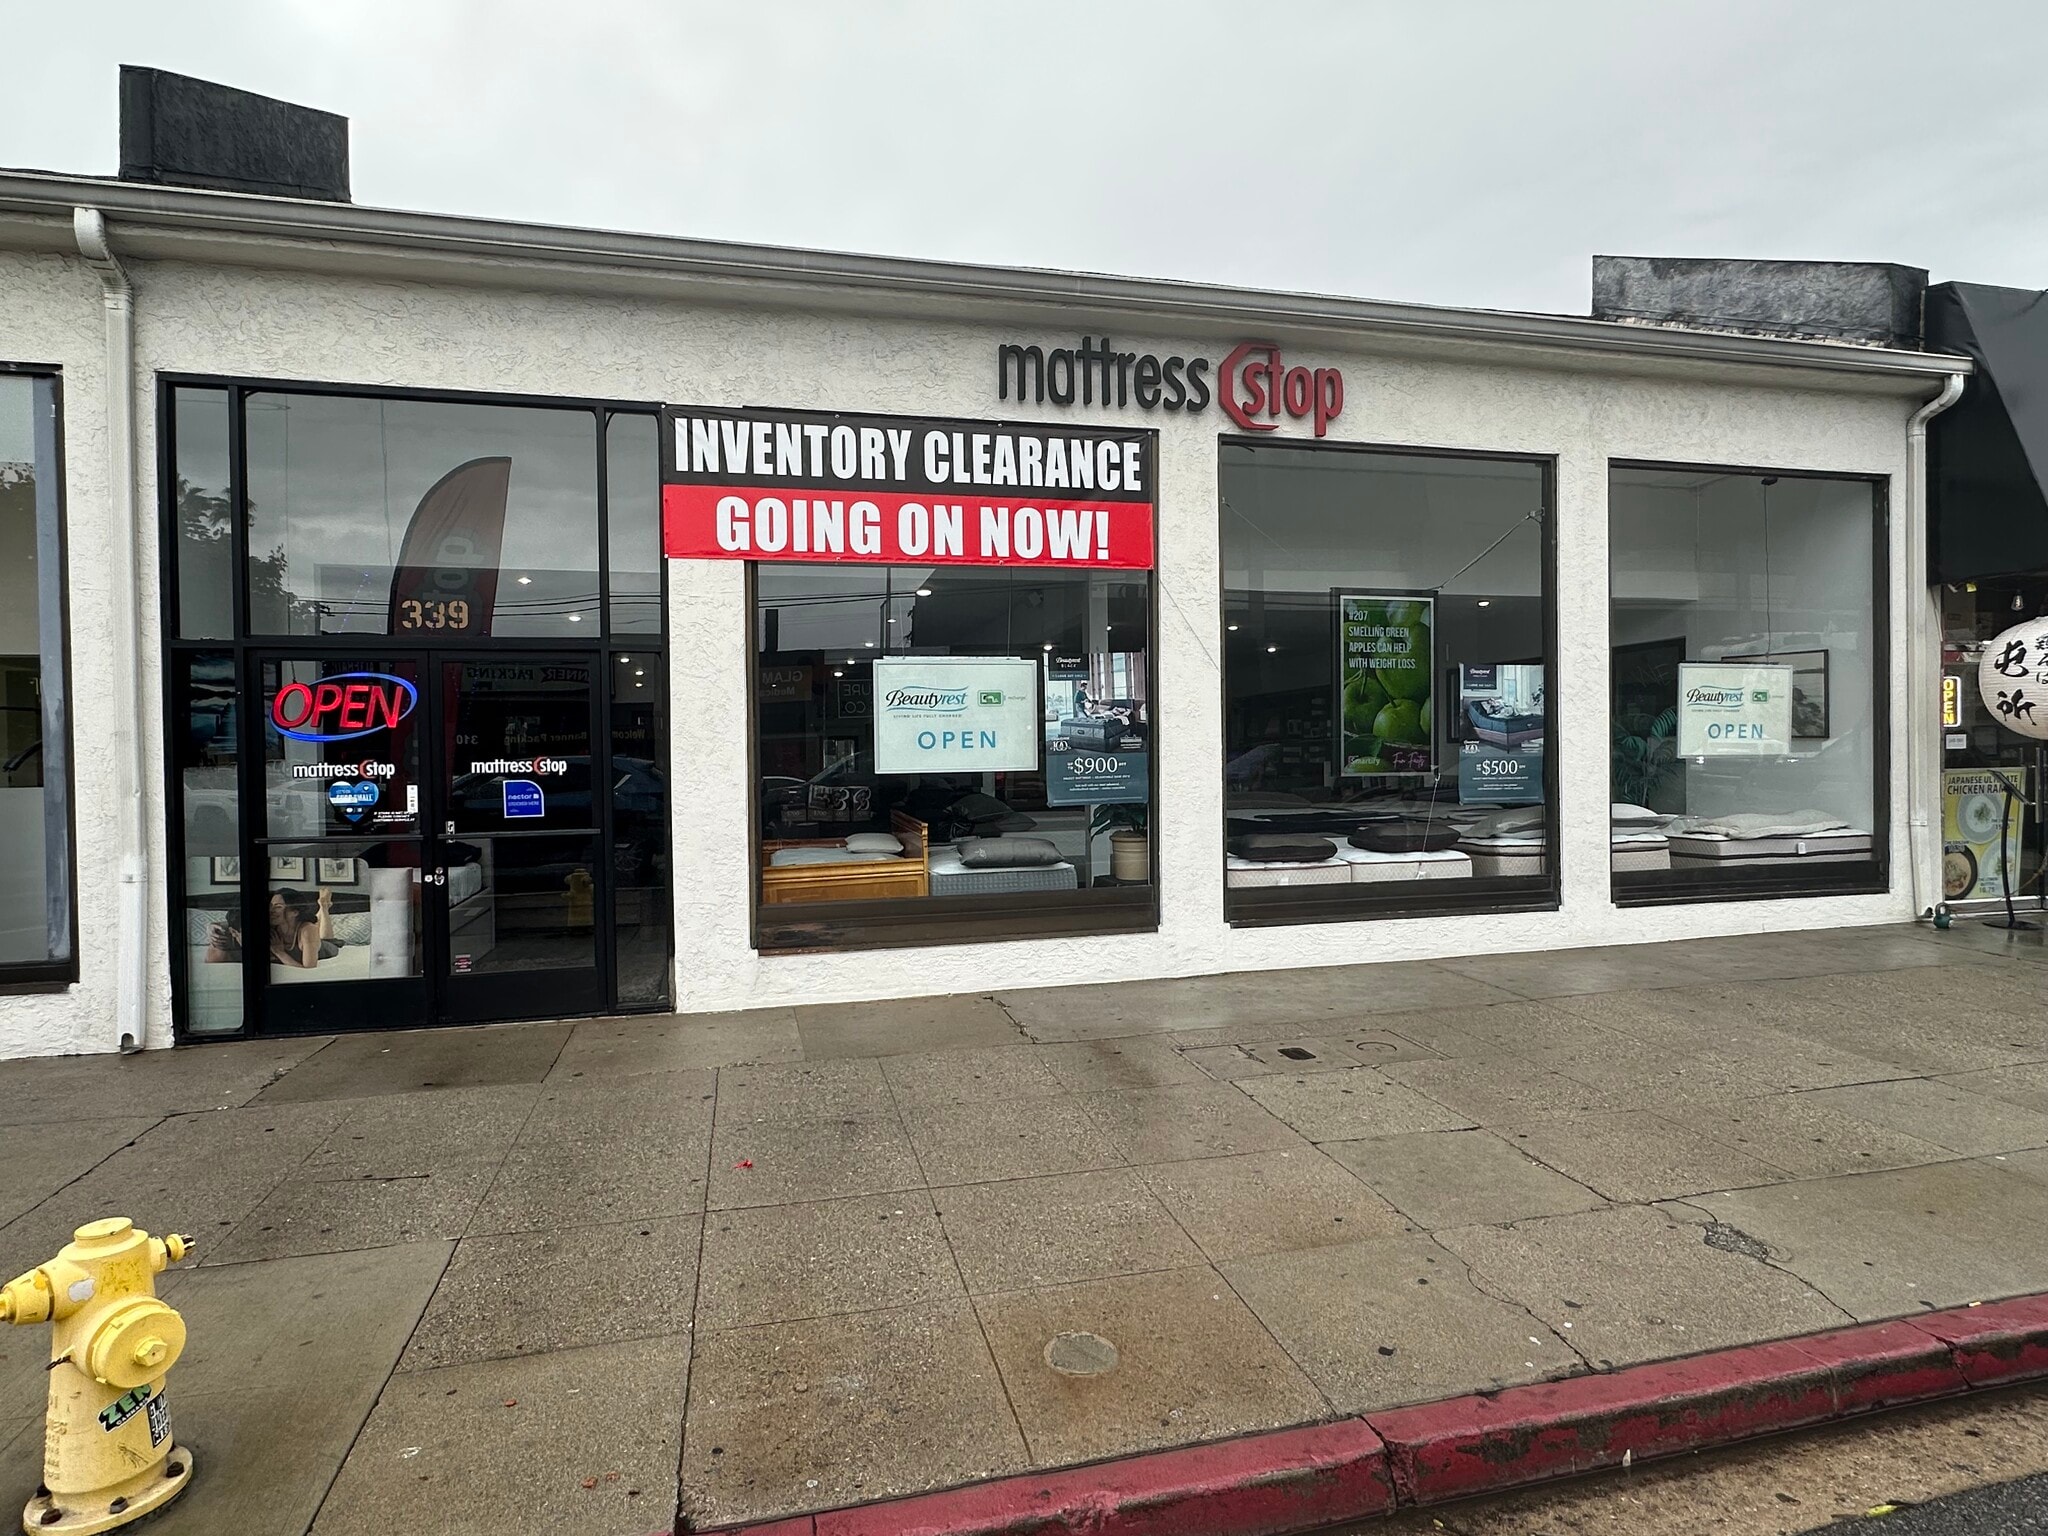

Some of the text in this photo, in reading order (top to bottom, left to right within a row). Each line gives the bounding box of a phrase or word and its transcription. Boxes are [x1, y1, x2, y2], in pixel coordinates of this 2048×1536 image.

[998, 336, 1344, 437] mattress stop
[675, 417, 1142, 492] INVENTORY CLEARANCE
[716, 496, 1110, 561] GOING ON NOW!
[402, 600, 469, 629] 339
[1348, 611, 1368, 621] #207
[1348, 626, 1409, 638] SMELLING GREEN
[1348, 642, 1412, 653] APPLES CAN HELP
[1348, 657, 1368, 669] WITH
[1369, 658, 1396, 669] WEIGHT
[273, 682, 404, 729] OPEN
[886, 690, 968, 708] Beautyrest
[1686, 688, 1744, 705] Beautyrest
[1943, 679, 1954, 725] OPEN
[917, 731, 996, 749] OPEN
[1708, 723, 1763, 739] OPEN
[293, 761, 395, 779] mattress stop
[471, 759, 567, 776] mattress stop
[1074, 757, 1118, 775] $900
[1481, 759, 1518, 776] $500
[1947, 774, 2019, 785] JAPANESE ULTIATE
[1947, 784, 1985, 795] CHICKEN
[101, 1384, 152, 1425] ZEN
